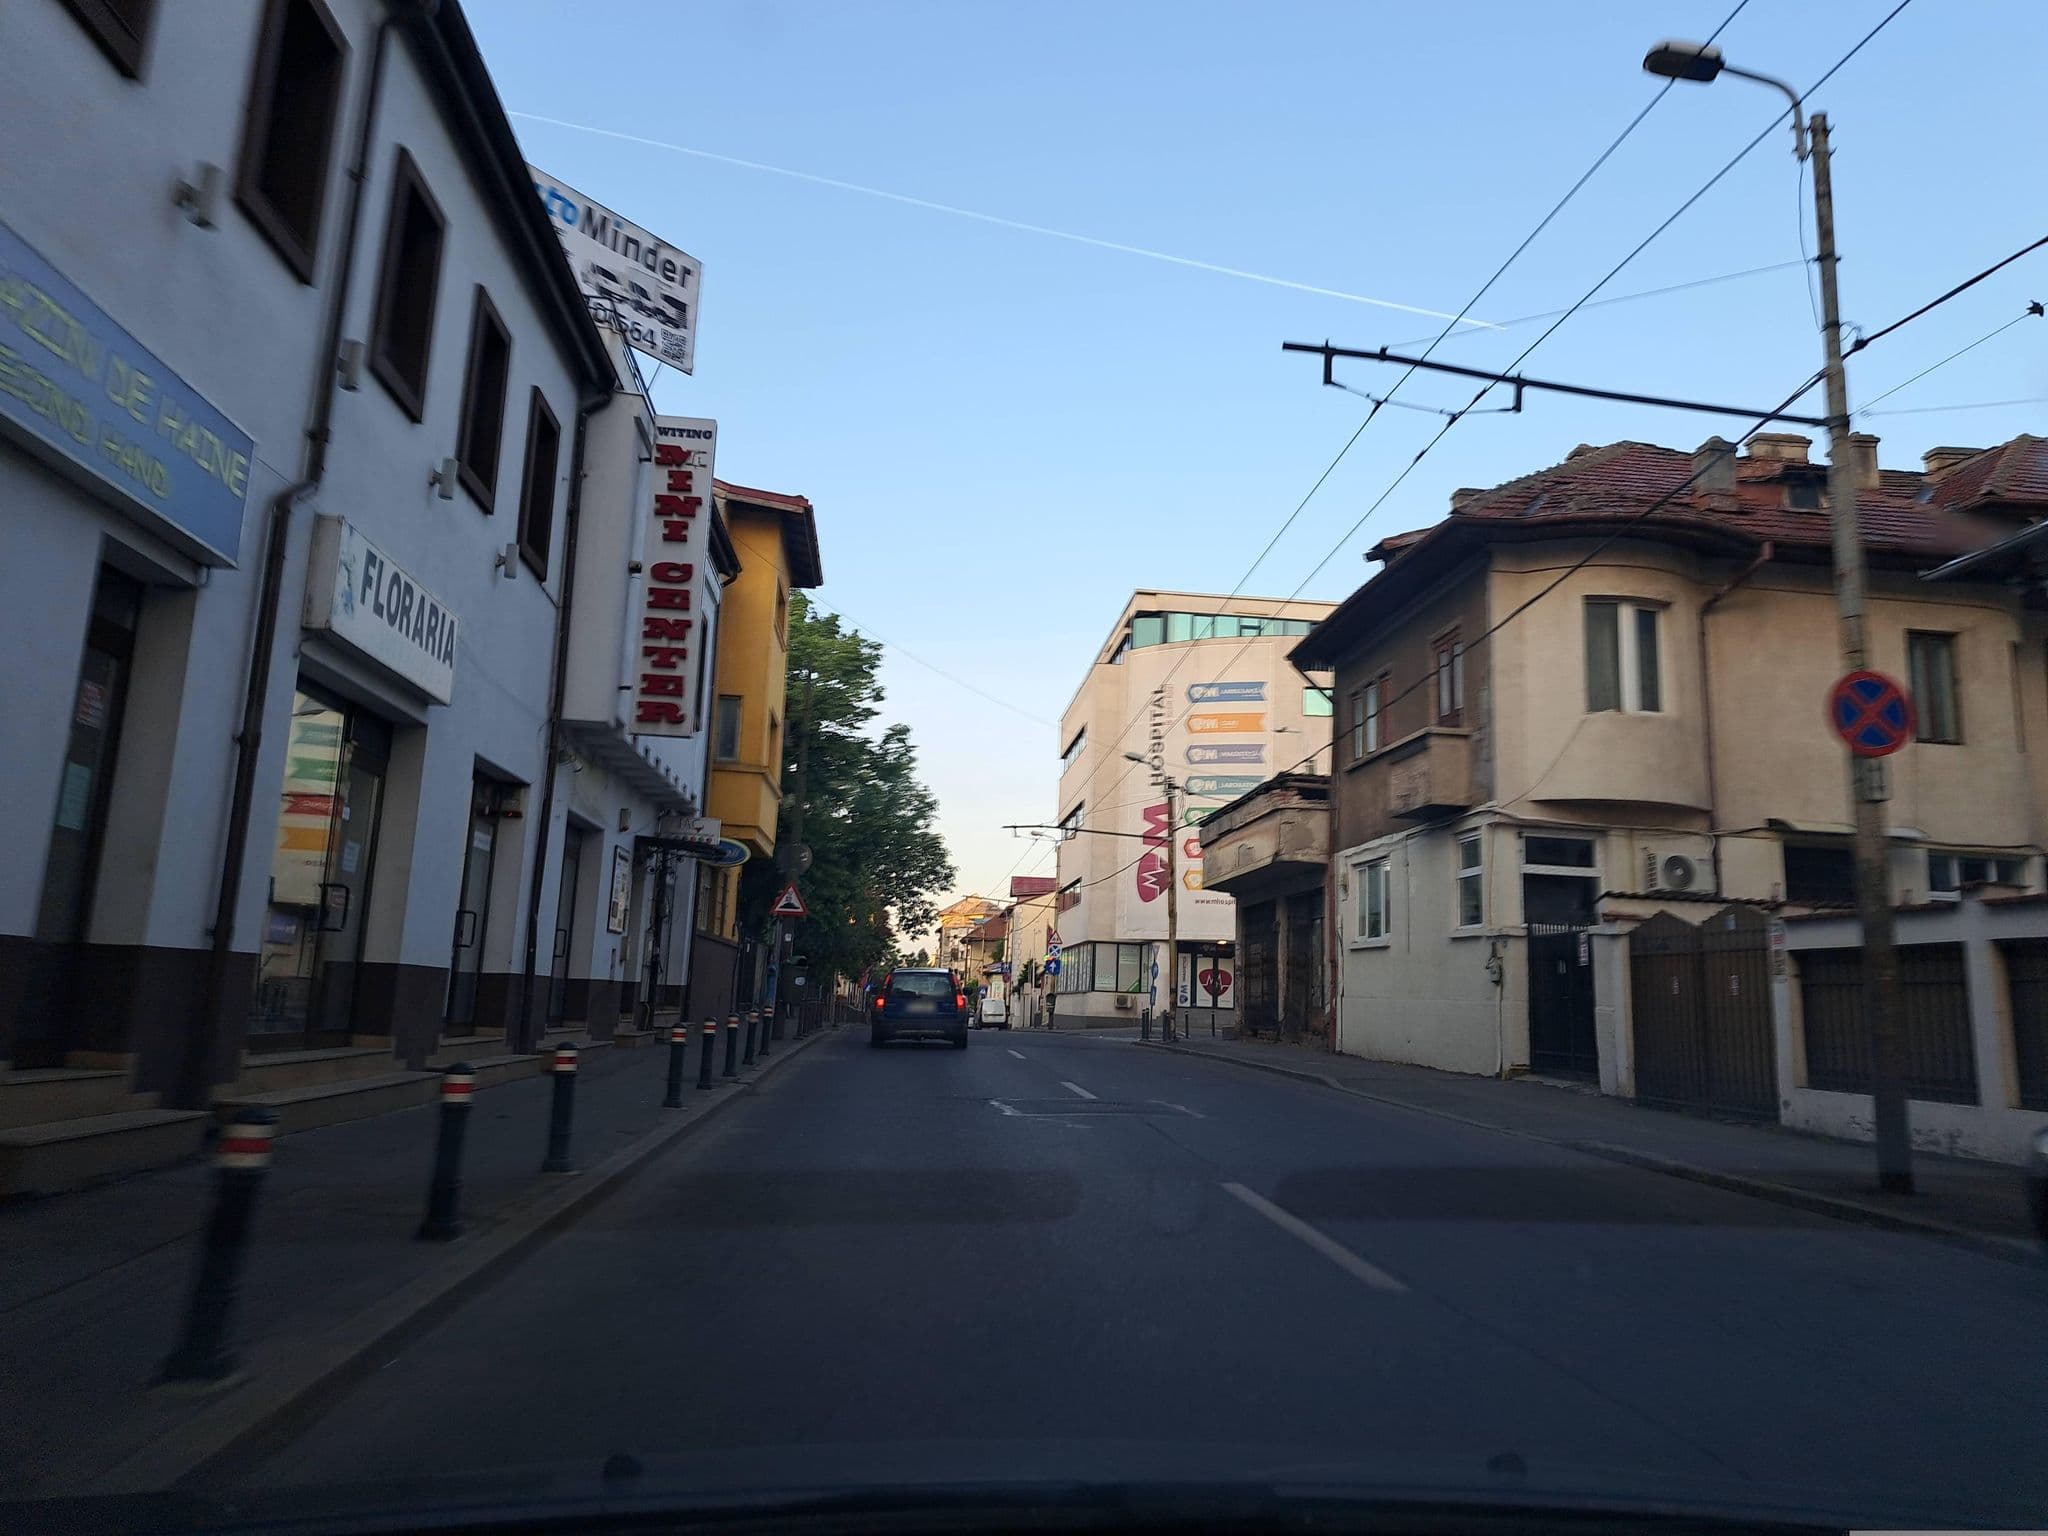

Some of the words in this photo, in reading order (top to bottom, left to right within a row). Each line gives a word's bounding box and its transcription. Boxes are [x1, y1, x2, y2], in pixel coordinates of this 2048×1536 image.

[107, 353, 156, 426] DE
[156, 394, 249, 500] HAINE
[656, 426, 713, 440] WITING
[359, 548, 457, 670] FLORARIA
[635, 562, 693, 724] CENTER
[1149, 684, 1166, 787] HOSPITAL
